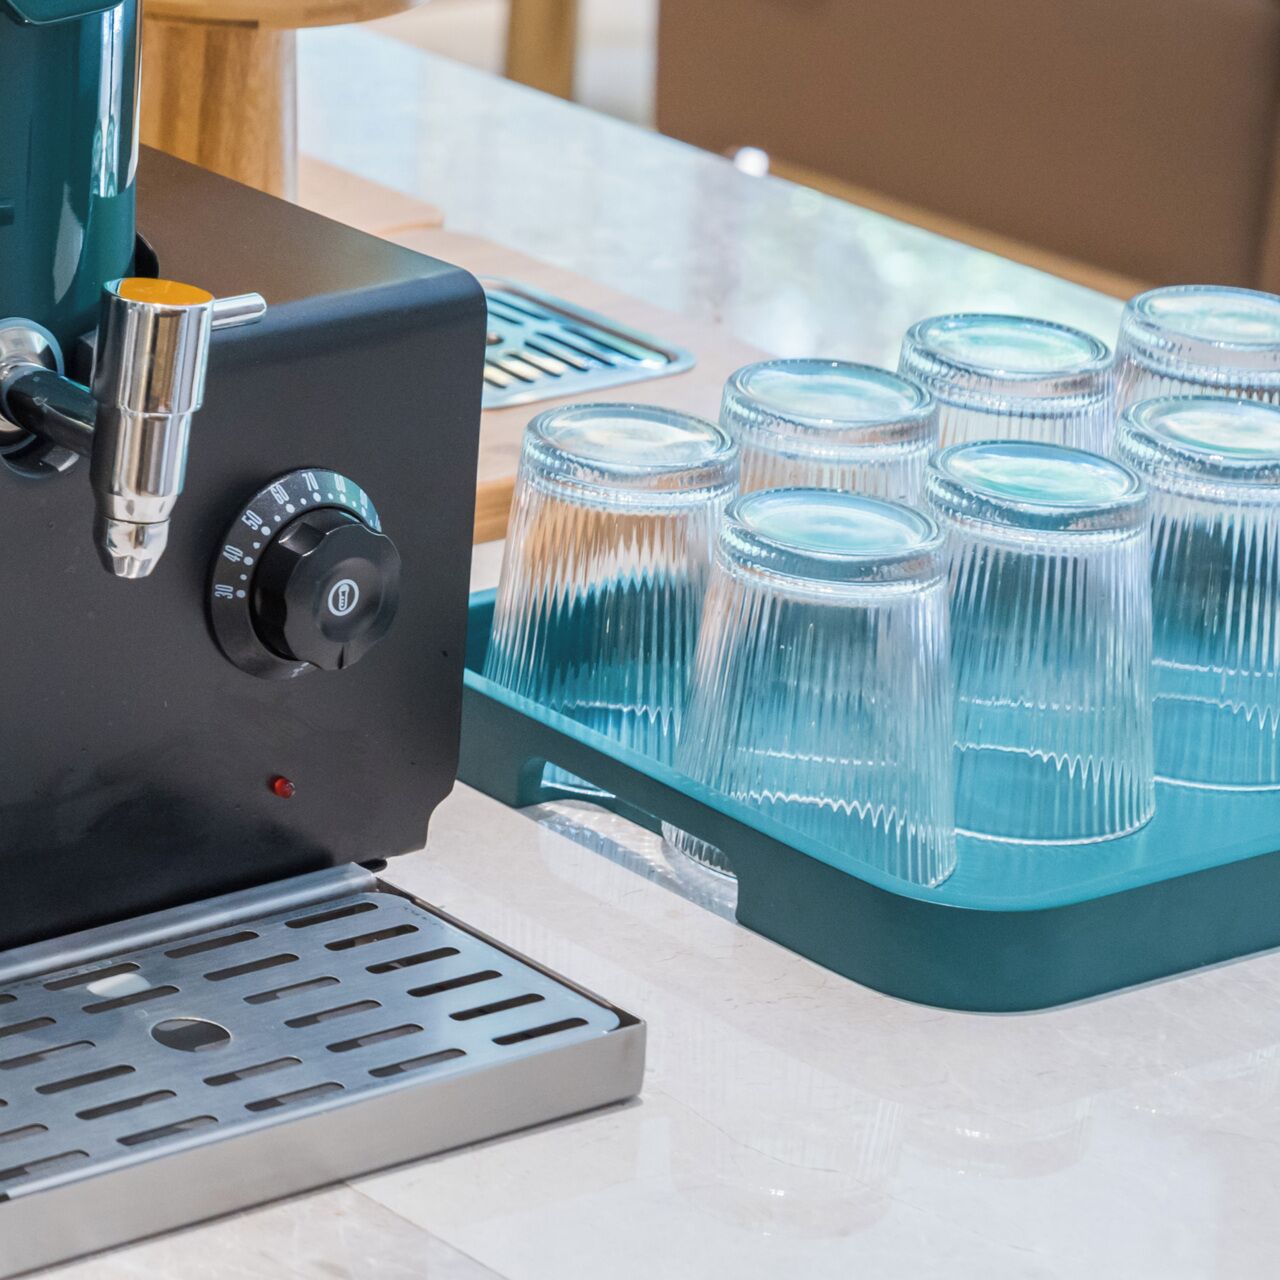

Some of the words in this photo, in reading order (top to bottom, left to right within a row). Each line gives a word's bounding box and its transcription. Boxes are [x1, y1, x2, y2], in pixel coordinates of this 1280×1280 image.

[301, 471, 319, 491] 70
[270, 484, 290, 505] 60
[241, 510, 263, 531] 50
[222, 545, 243, 562] 40
[214, 584, 233, 599] 30
